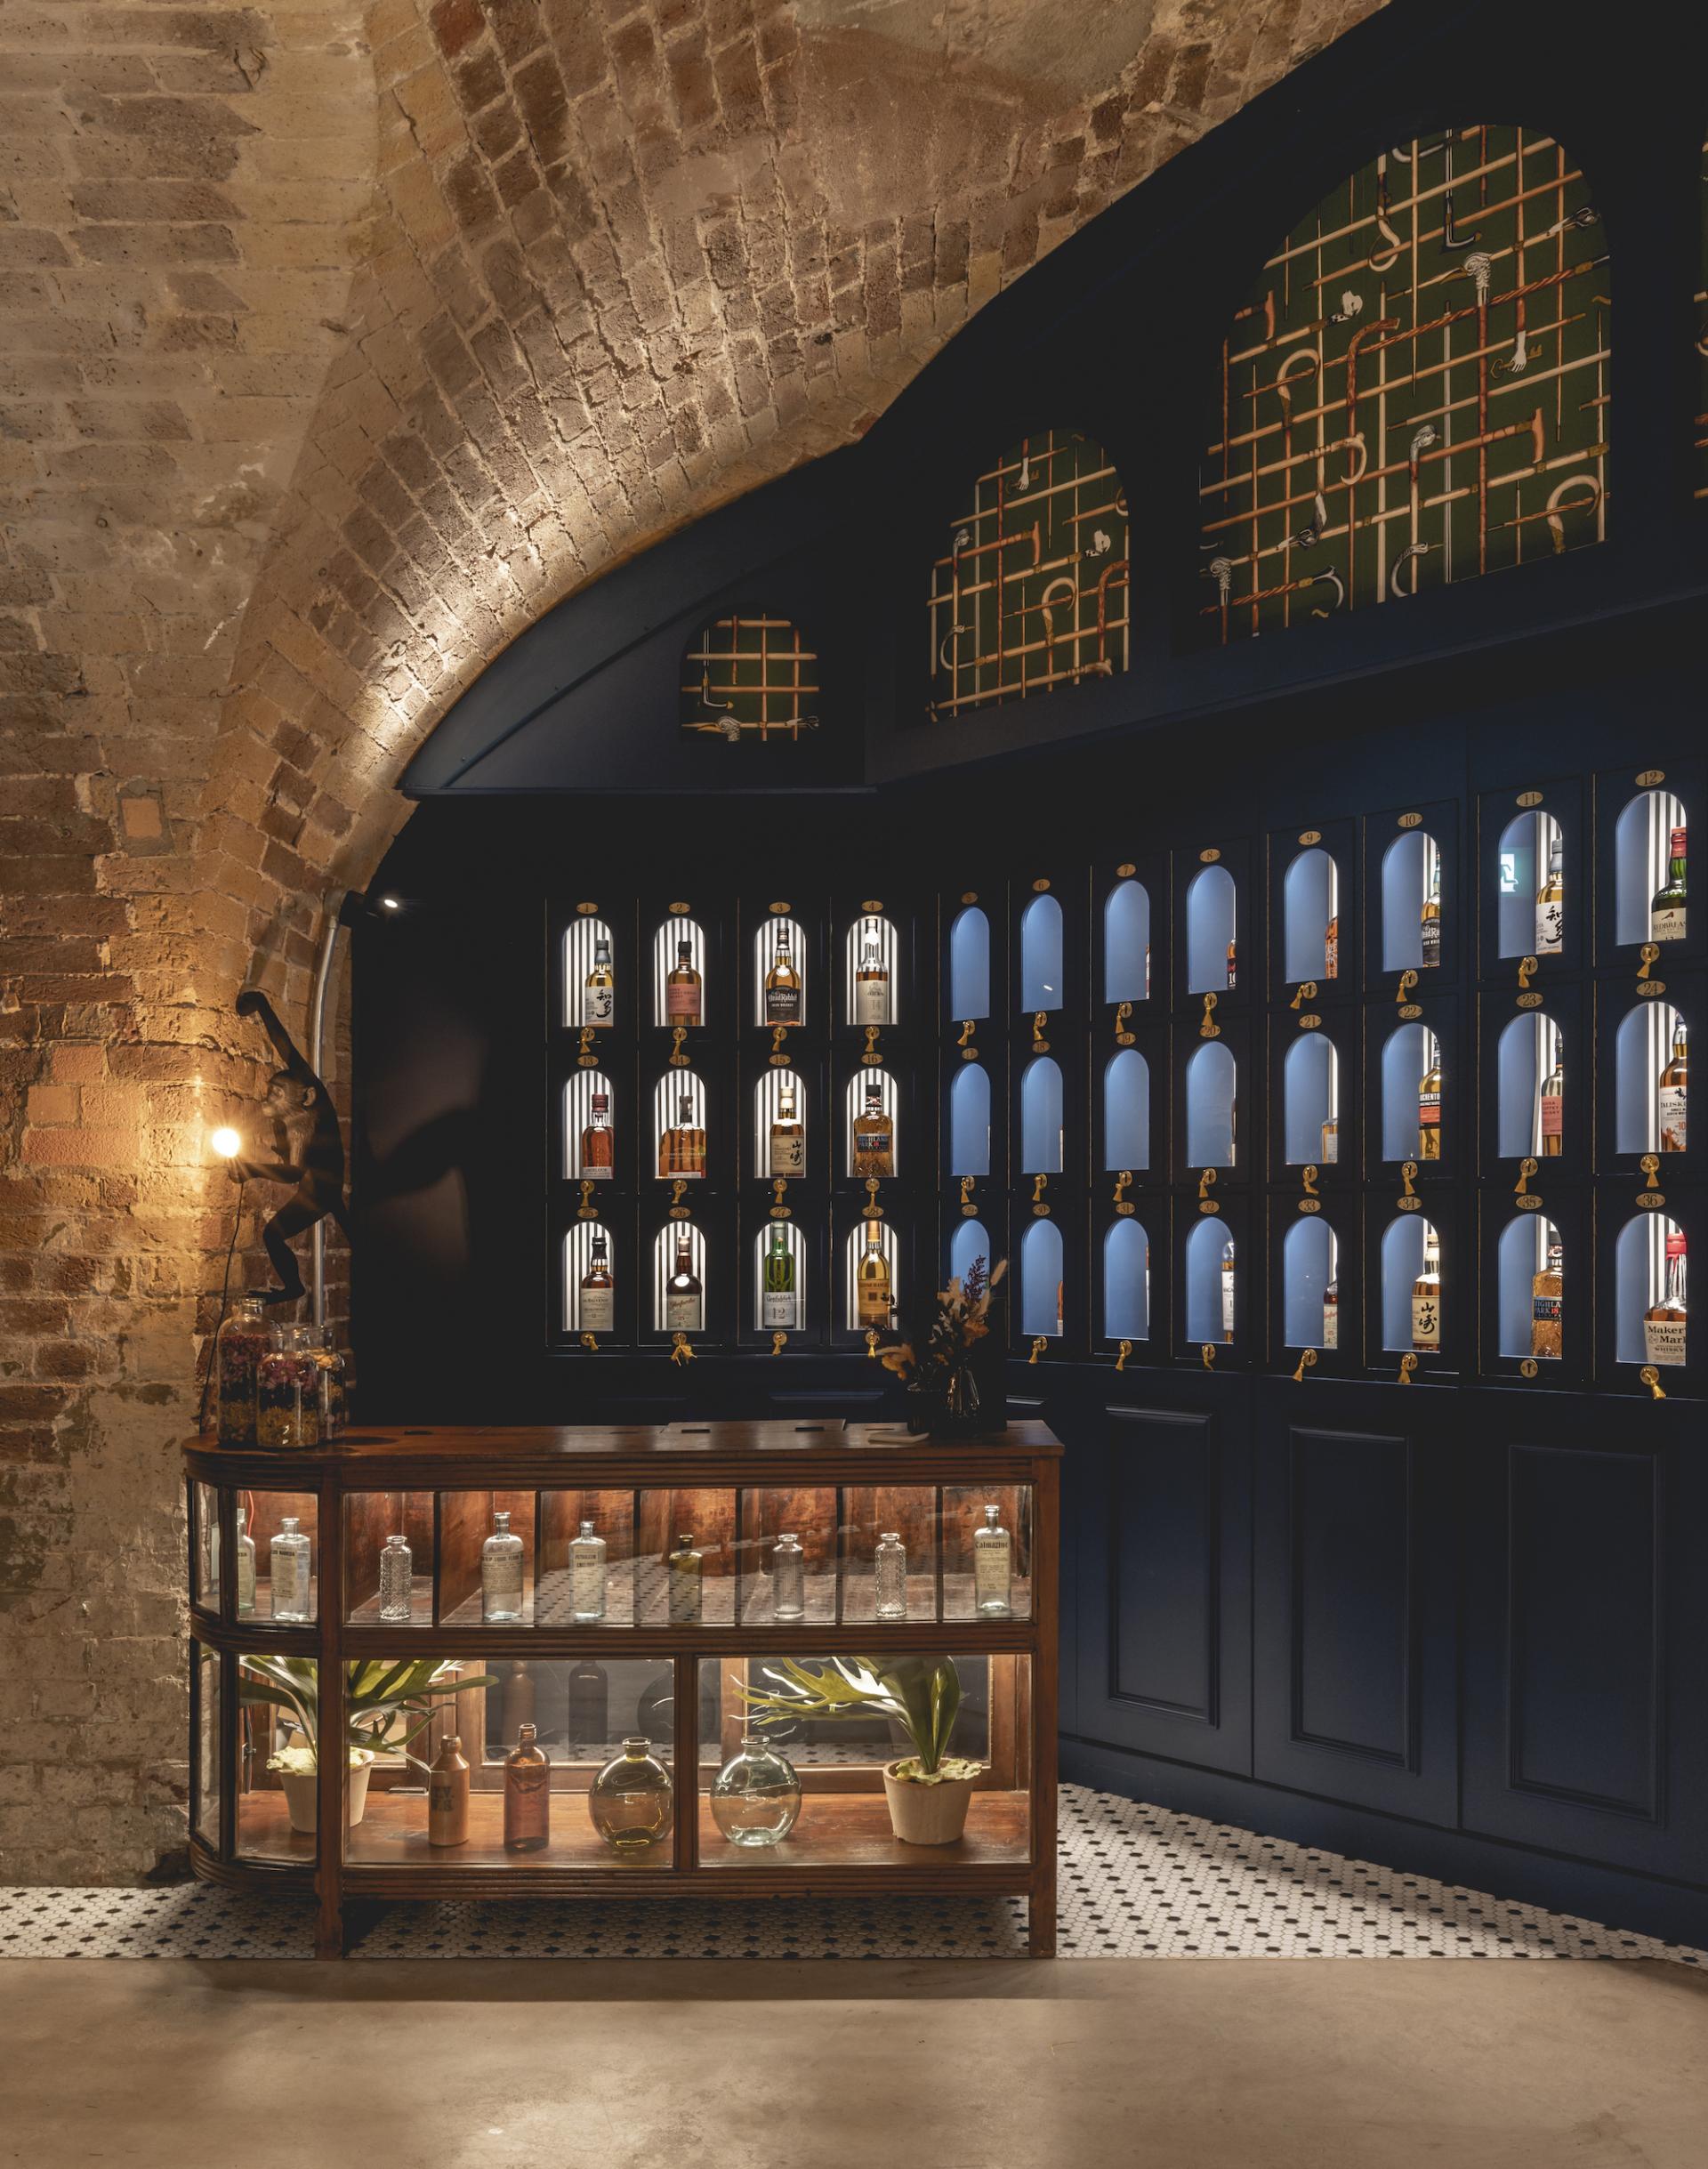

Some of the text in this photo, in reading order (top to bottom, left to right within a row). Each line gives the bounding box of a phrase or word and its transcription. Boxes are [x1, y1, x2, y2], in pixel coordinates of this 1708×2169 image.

[1645, 771, 1657, 786] 12
[1525, 793, 1535, 805] 11
[1406, 815, 1416, 826] 10
[1643, 982, 1657, 996] 24
[1522, 994, 1536, 1006] 23
[1404, 1006, 1416, 1018] 22
[1304, 1016, 1316, 1028] 21
[1205, 1026, 1216, 1036] 20
[776, 1055, 786, 1064] 15
[867, 1054, 878, 1063] 16
[1303, 1200, 1315, 1212] 33
[1404, 1197, 1414, 1210] 34
[1523, 1196, 1536, 1208] 35
[1643, 1194, 1658, 1206] 36
[772, 1307, 786, 1318] 12
